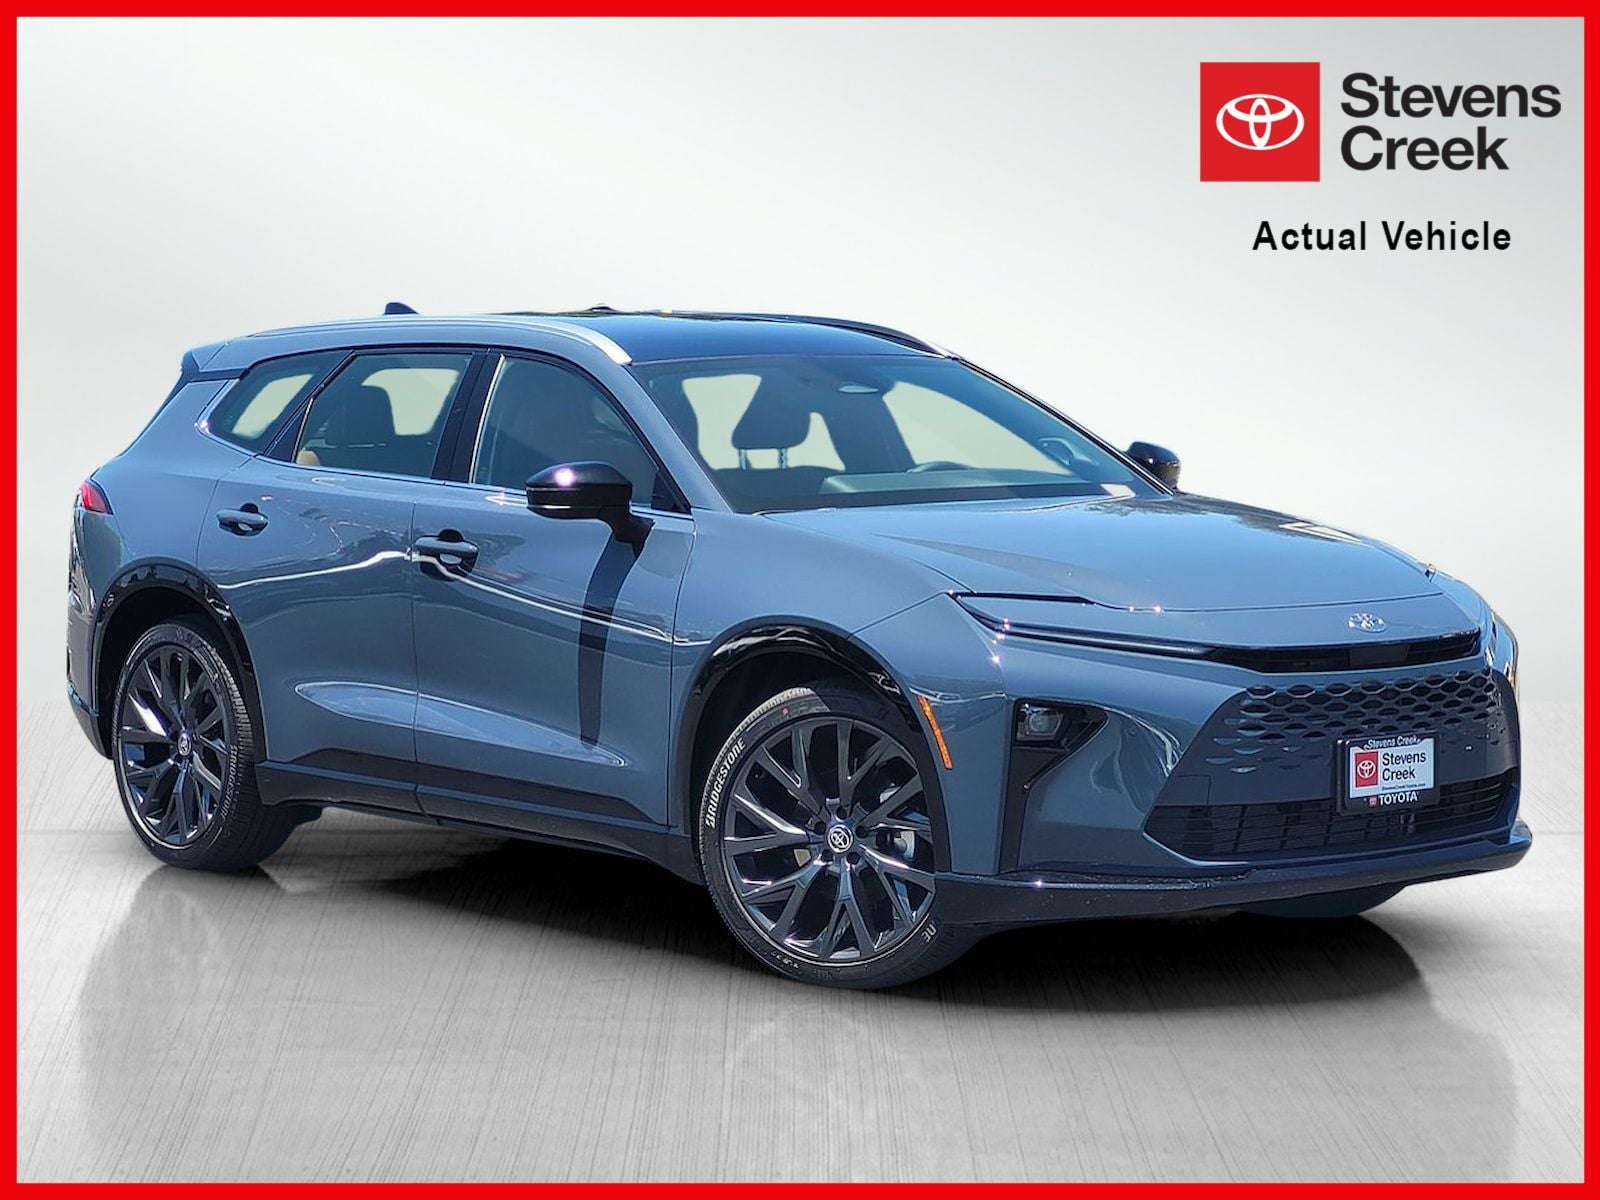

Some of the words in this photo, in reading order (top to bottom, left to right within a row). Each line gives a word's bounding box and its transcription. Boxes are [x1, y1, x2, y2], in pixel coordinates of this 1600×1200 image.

[1382, 752, 1427, 766] Stevens
[1382, 766, 1416, 781] Creek
[705, 737, 747, 829] BRIDGESTONE
[1379, 791, 1418, 805] TOYOTA
